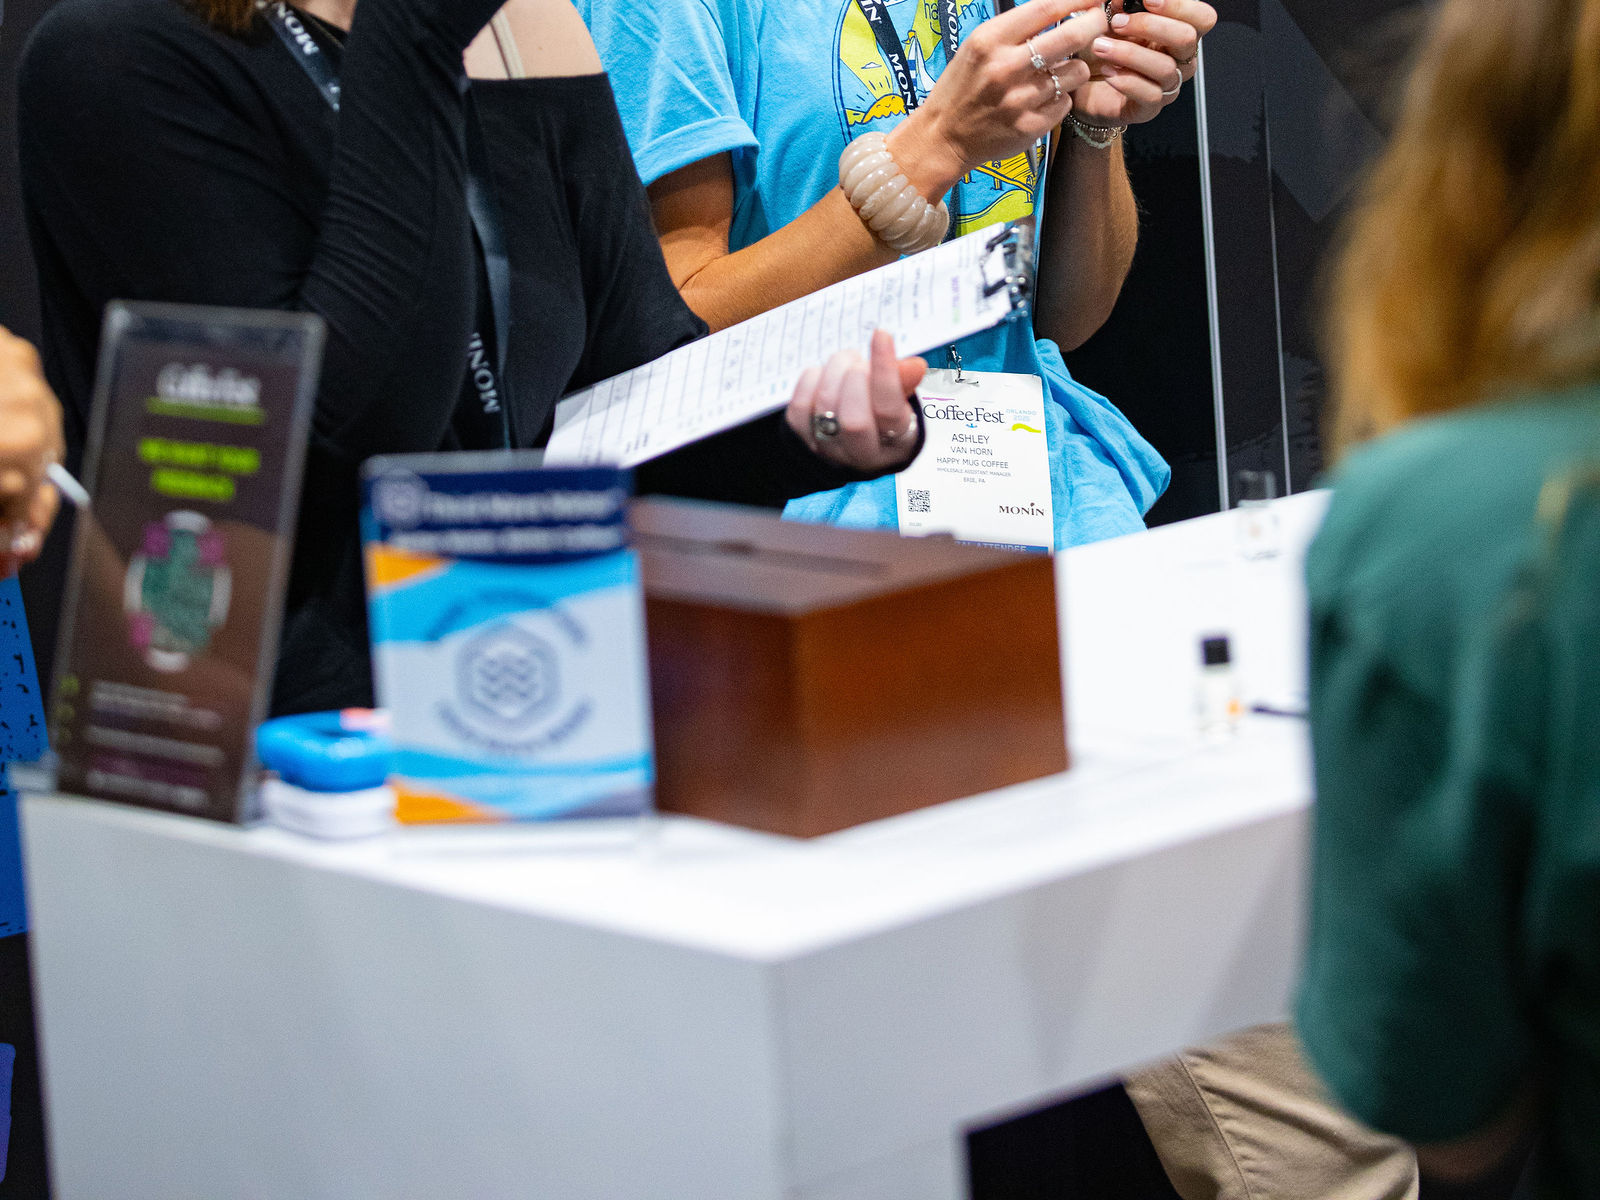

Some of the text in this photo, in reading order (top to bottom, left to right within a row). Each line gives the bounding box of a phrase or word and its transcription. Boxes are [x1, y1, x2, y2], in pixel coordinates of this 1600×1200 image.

[951, 433, 990, 444] ASHLEY
[950, 446, 993, 456] VAN HORN
[936, 457, 1009, 469] HAPPY MUG COFFEE
